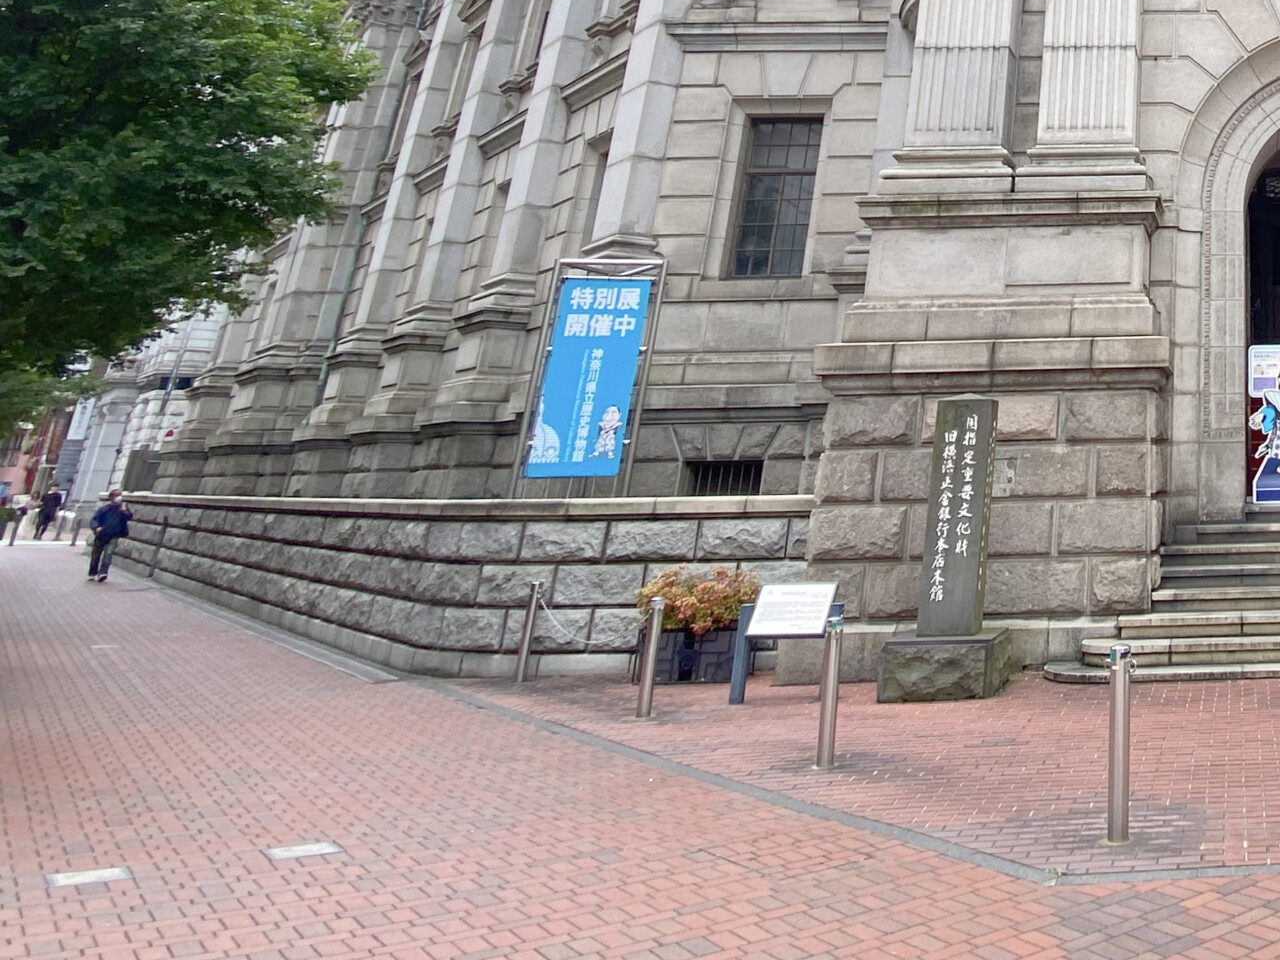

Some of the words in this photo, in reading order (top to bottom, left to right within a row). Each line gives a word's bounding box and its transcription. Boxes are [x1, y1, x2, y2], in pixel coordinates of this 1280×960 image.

[570, 287, 641, 311] 特別展
[563, 314, 636, 338] 開催中
[571, 348, 604, 463] 神奈川県立歴史博物館
